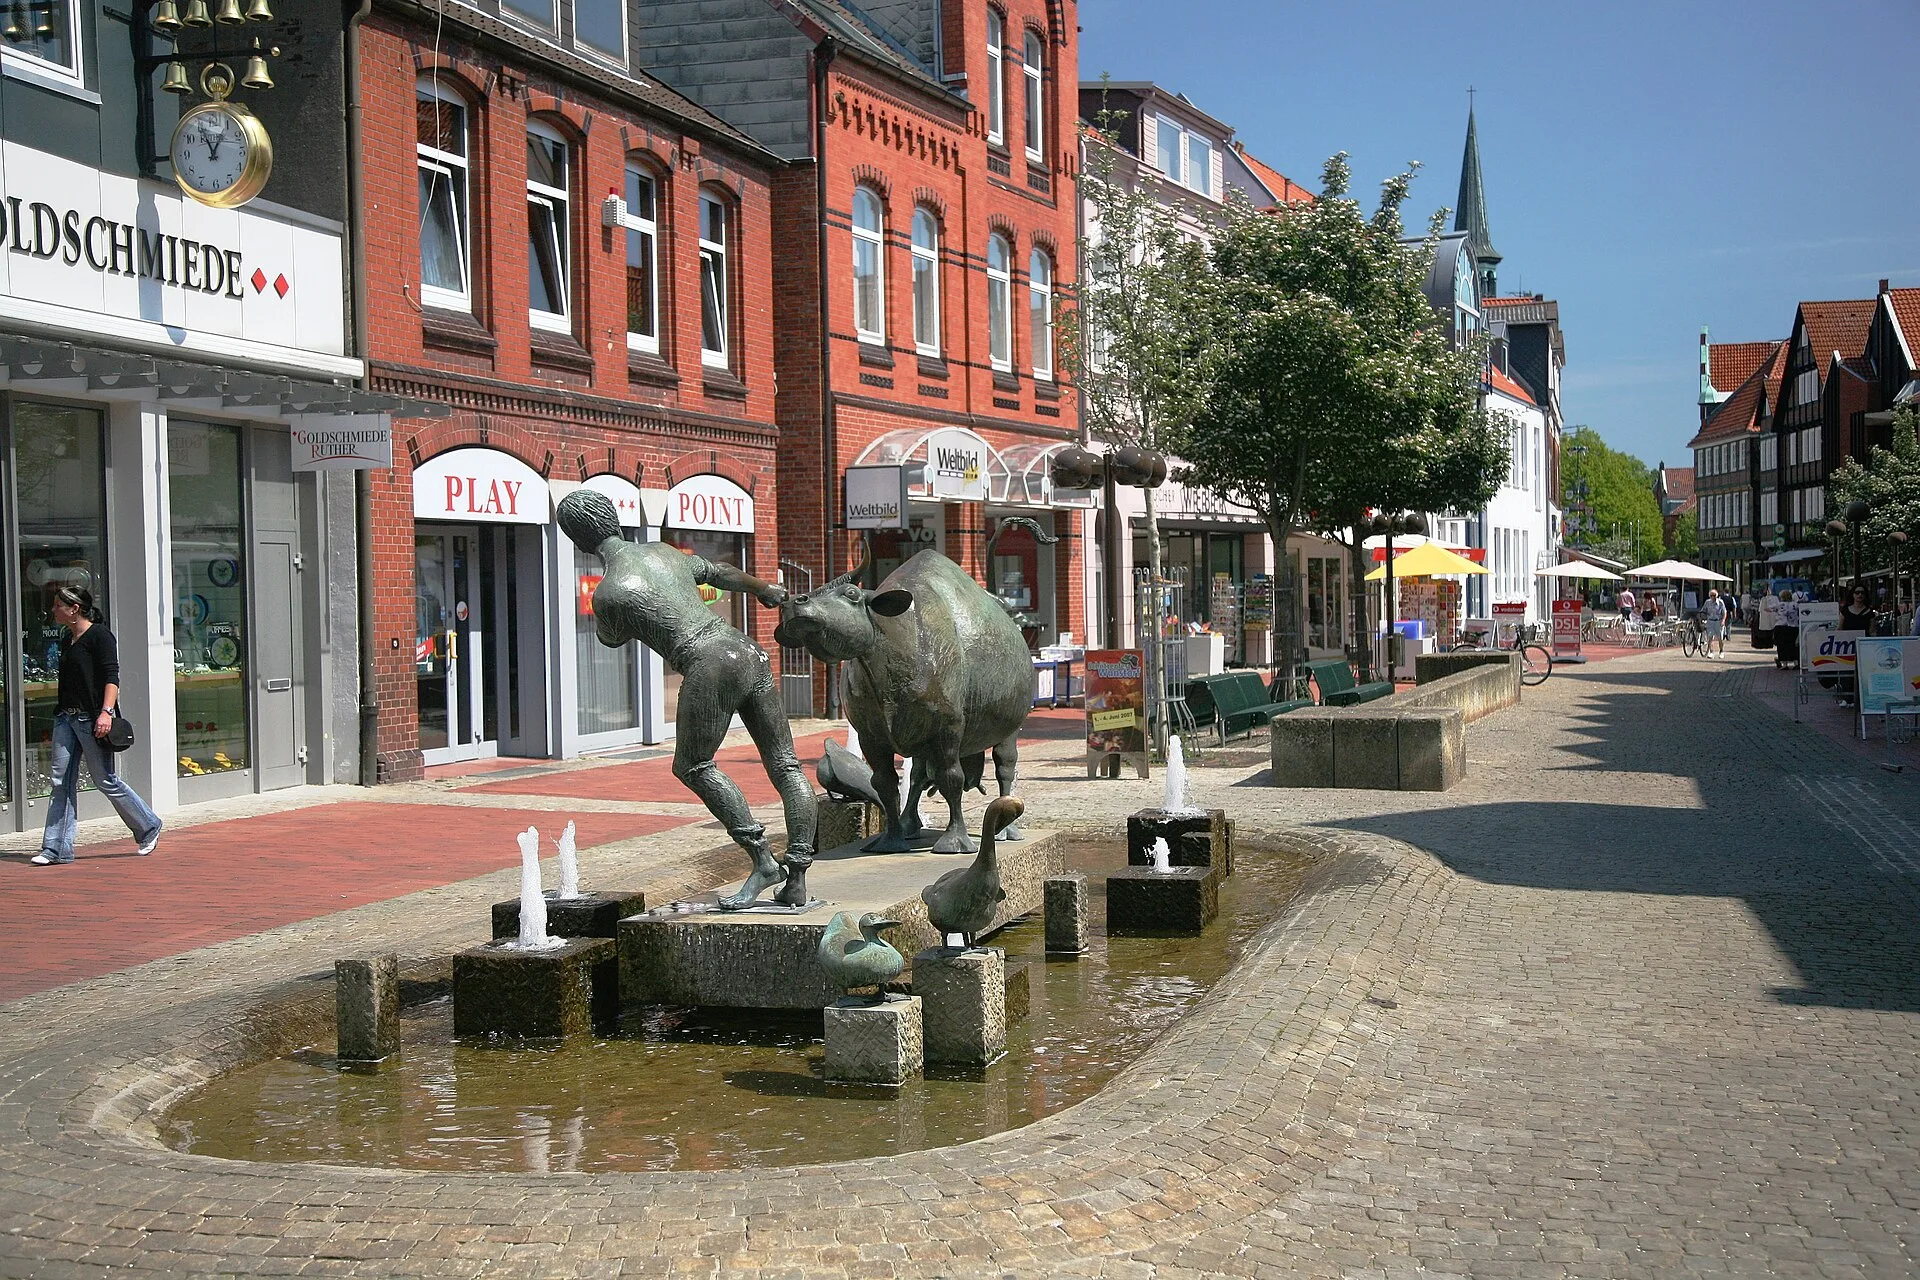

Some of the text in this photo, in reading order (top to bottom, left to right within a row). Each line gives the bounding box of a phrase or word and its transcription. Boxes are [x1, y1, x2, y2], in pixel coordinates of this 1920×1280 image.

[0, 196, 244, 299] LDSCHMIEDE
[297, 430, 387, 445] GOLDSCHMIEDE
[311, 444, 360, 459] RUTHER
[937, 447, 978, 471] Weltbild
[444, 475, 522, 515] PLAY
[678, 492, 745, 526] POINT
[849, 503, 898, 516] Weltbild
[1555, 618, 1579, 630] DSL
[1819, 635, 1856, 655] dm
